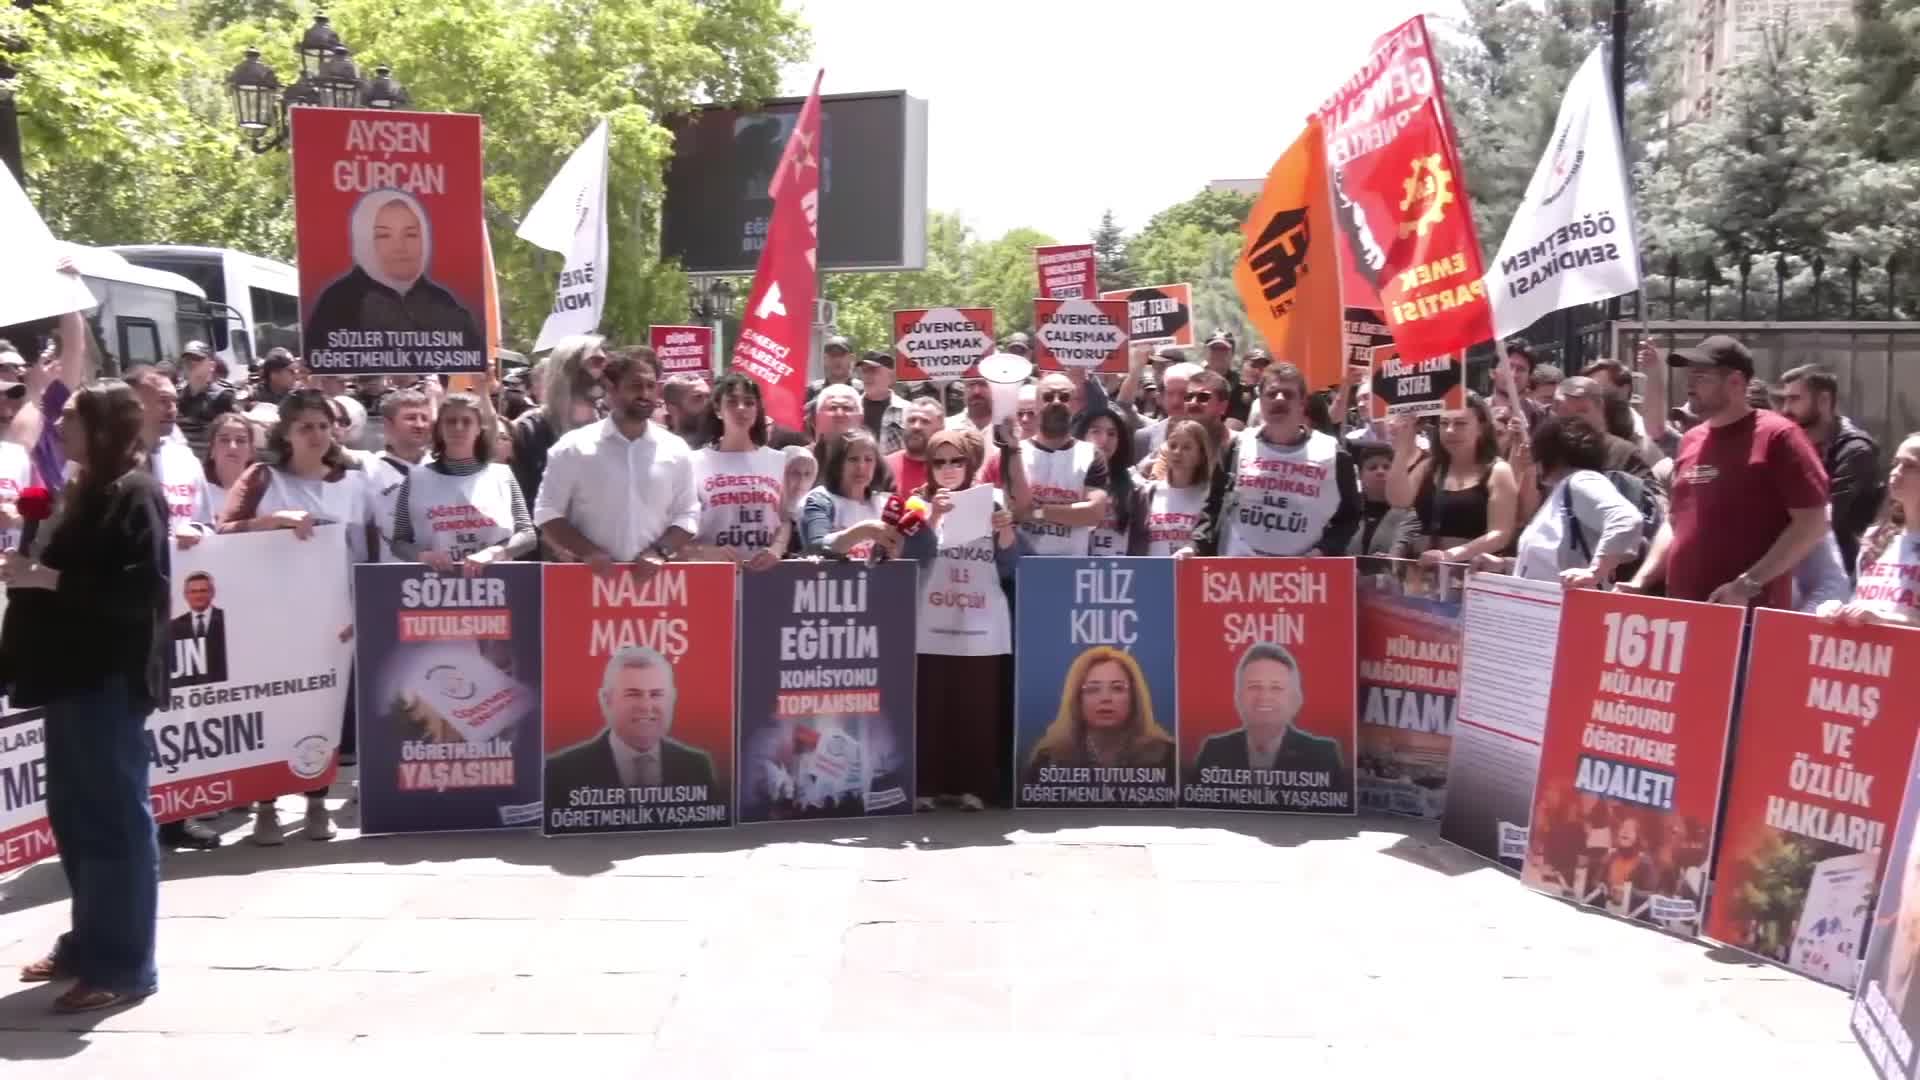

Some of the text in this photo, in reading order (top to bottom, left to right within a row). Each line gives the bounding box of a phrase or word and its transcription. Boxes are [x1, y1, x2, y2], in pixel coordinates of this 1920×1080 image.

[346, 119, 430, 159] AYŞEN
[333, 155, 447, 194] GÜRCAN
[328, 329, 463, 348] SÖZLER TUTULSUN
[906, 335, 983, 355] ÇALIŞMAK
[1044, 330, 1117, 345] ÇALIŞMAK
[310, 348, 481, 370] ÖĞRETMENLİK YAŞASIN!
[736, 342, 796, 377] HAREKET
[739, 505, 764, 523] İLE
[1263, 492, 1289, 508] İLE
[1239, 506, 1309, 534] GÜÇLÜ!
[401, 571, 506, 608] SÖZLER
[592, 569, 688, 607] NAZIM
[792, 571, 868, 614] MİLLİ
[1074, 562, 1135, 604] FİLİZ
[1202, 566, 1328, 604] İSA MESİH
[403, 614, 507, 637] TUTULSUN!
[588, 611, 689, 665] MAVİŞ
[780, 618, 879, 661] EĞİTİM
[1070, 608, 1139, 656] KILIÇ
[1223, 607, 1305, 652] ŞAHİN
[1602, 611, 1689, 675] 1611
[1807, 634, 1894, 678] TABAN
[189, 668, 338, 708] ÖĞRETMENLERİ
[780, 665, 878, 689] KOMİSYONU
[1598, 668, 1676, 703] MÜLAKAT
[778, 692, 880, 716] TOPLANSIN!
[1590, 699, 1676, 734] MAĞDURU
[1806, 677, 1880, 727] MAAŞ
[149, 710, 264, 775] AŞASIN!
[402, 736, 513, 761] ÖĞRETMENLİK
[1581, 722, 1678, 767] ÖĞRETMENE
[1821, 721, 1856, 758] VE
[400, 758, 514, 793] YAŞASIN!
[1039, 764, 1166, 783] SÖZLER TUTULSUN
[1200, 766, 1330, 788] SÖZLER TUTULSUN
[1574, 756, 1676, 810] ADALET!
[1788, 752, 1875, 808] ÖZLÜK
[569, 785, 707, 808] SÖZLER TUTULSUN
[1022, 784, 1178, 806] ÖĞRETMENLİK YAŞASIN
[1184, 784, 1348, 810] ÖĞRETMENLİK YAŞASIN!
[551, 804, 656, 829] ÖĞRETMENLİK
[658, 803, 726, 827] YAŞASIN!
[1765, 794, 1886, 854] HAKLARI!
